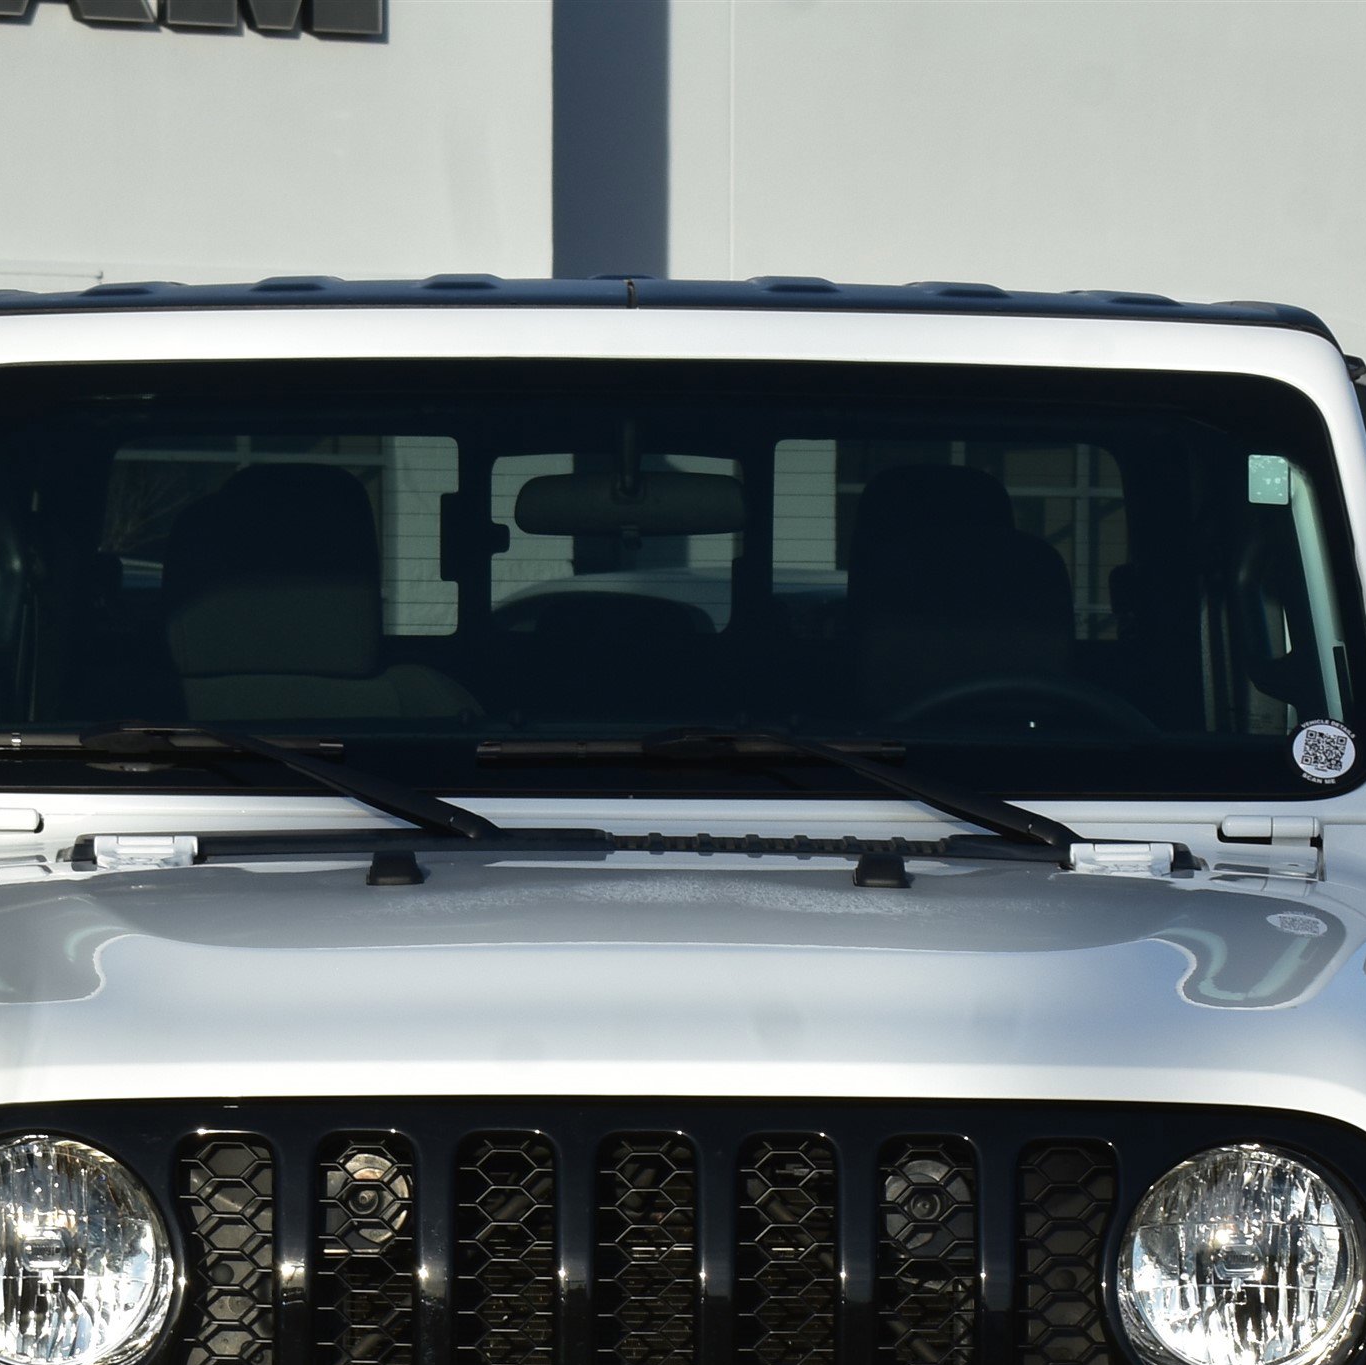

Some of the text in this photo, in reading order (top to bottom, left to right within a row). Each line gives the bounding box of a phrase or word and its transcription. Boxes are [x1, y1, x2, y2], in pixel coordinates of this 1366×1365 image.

[1301, 719, 1355, 738] VEHICLE DETAILS
[1302, 773, 1322, 784] SCAN
